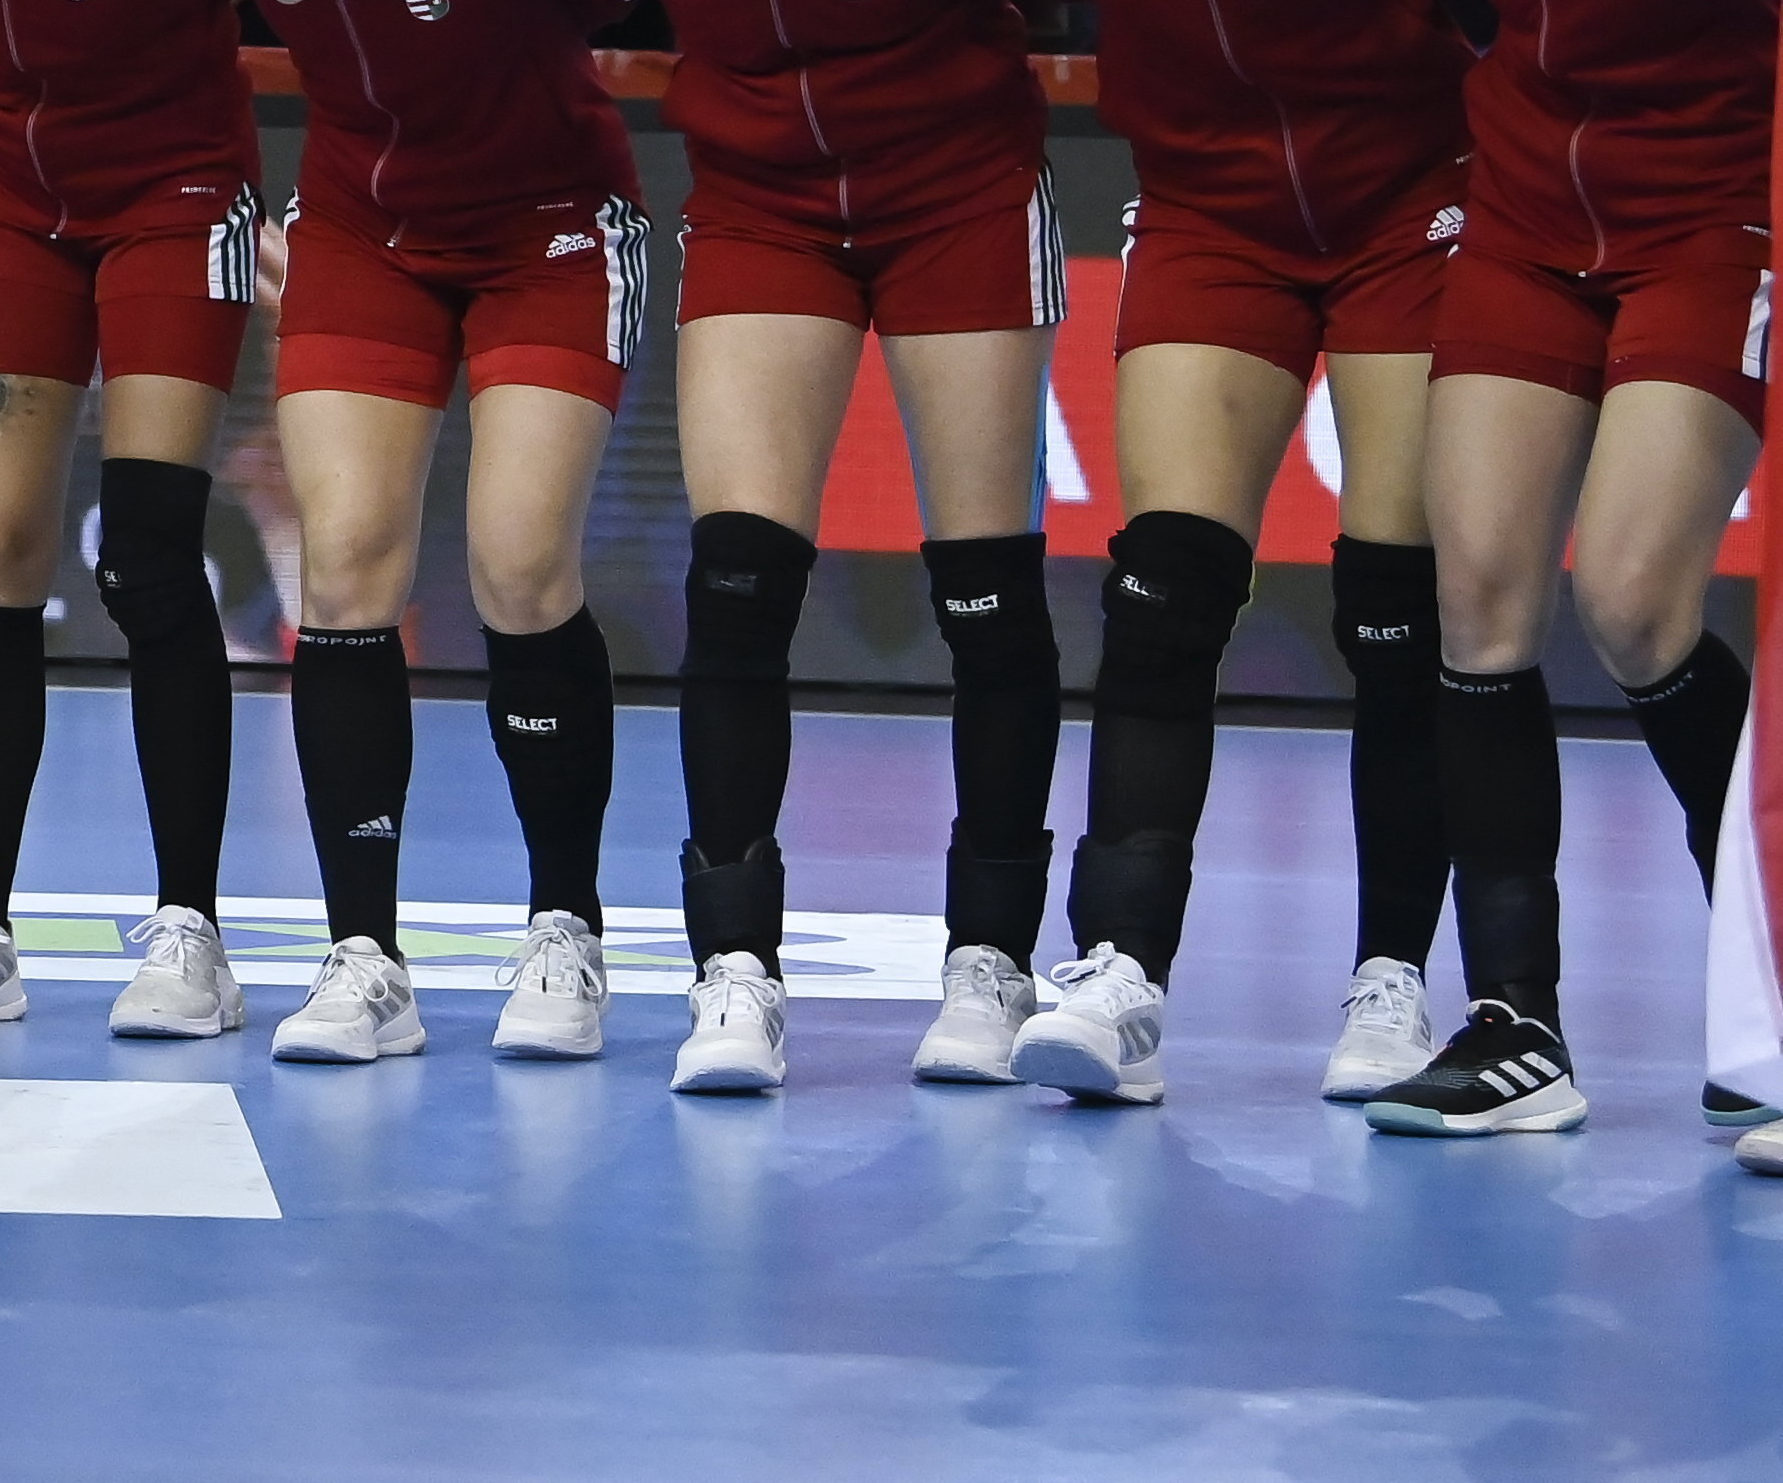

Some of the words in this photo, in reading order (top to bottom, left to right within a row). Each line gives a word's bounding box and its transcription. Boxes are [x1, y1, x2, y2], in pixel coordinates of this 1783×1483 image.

[544, 236, 597, 260] adidas
[944, 593, 1001, 614] SELECT
[1355, 624, 1411, 642] SELECT
[505, 714, 559, 733] SELECT
[347, 822, 397, 840] adidas
